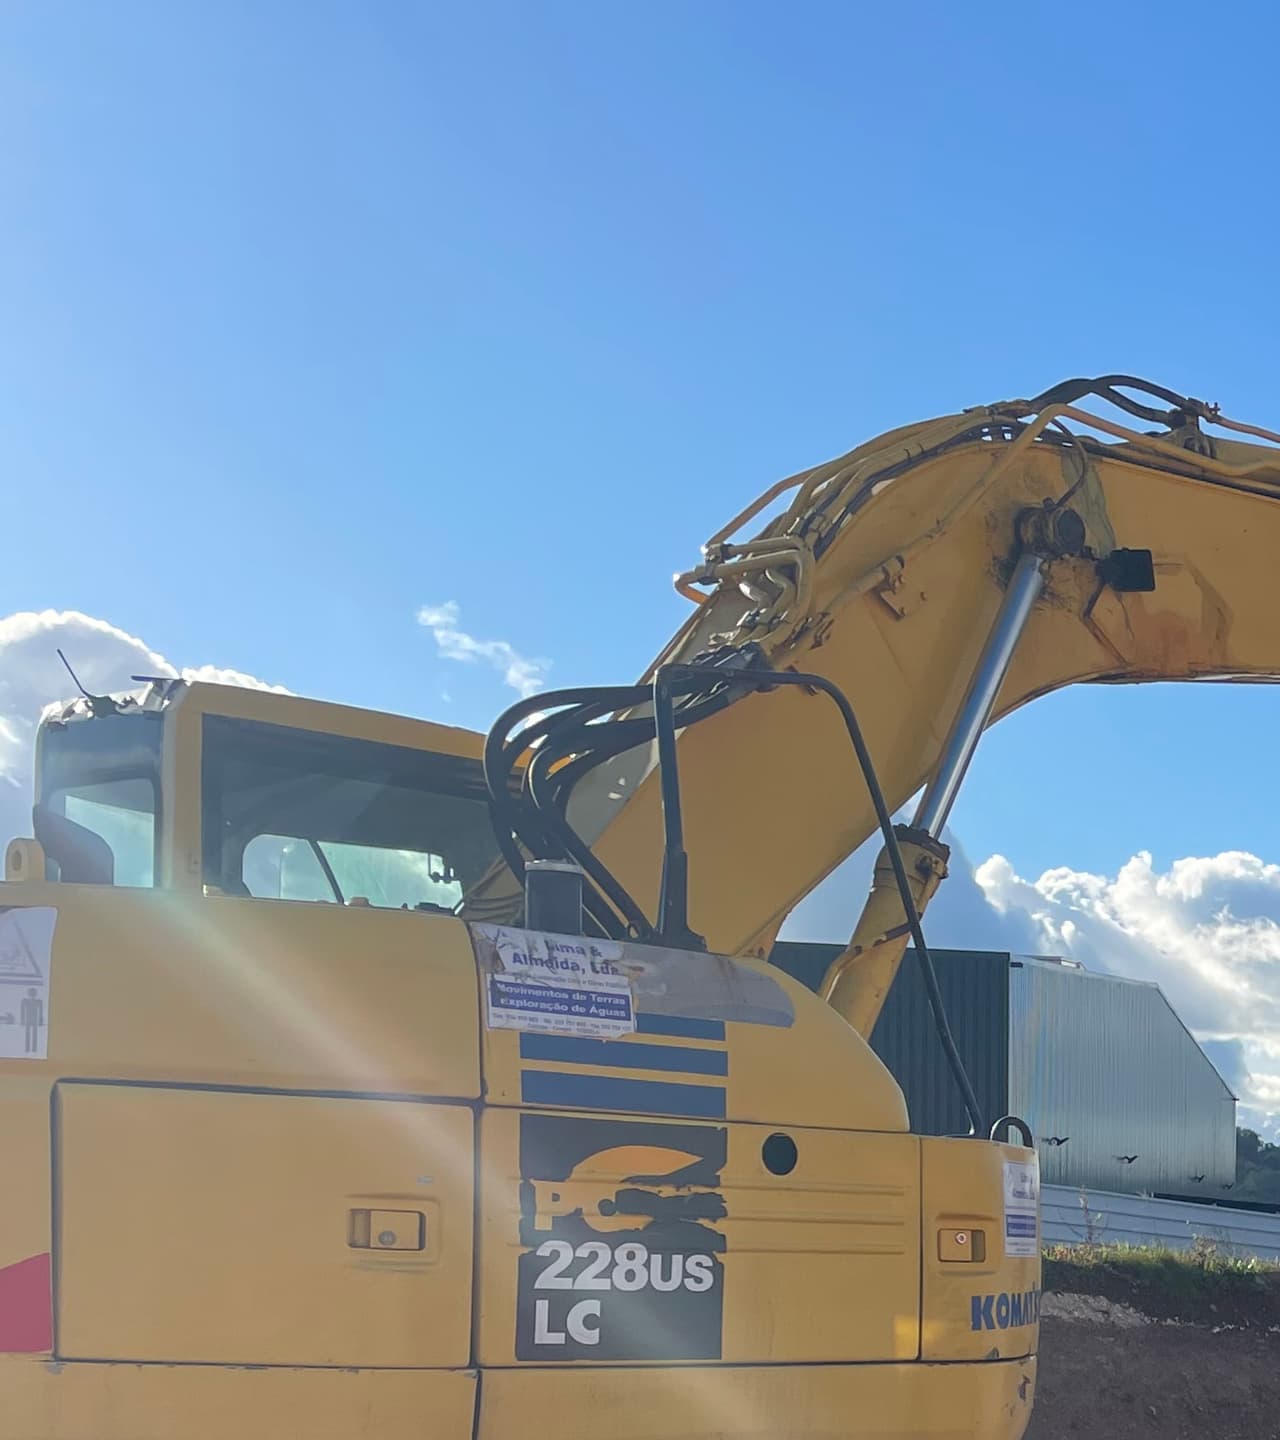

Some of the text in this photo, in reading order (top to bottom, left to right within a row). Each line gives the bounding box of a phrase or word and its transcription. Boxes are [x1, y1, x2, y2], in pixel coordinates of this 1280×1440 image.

[571, 1003, 586, 1013] de
[589, 1003, 627, 1018] Águas
[590, 993, 626, 1005] Terras
[533, 1240, 714, 1292] 228US
[534, 1299, 601, 1345] LC
